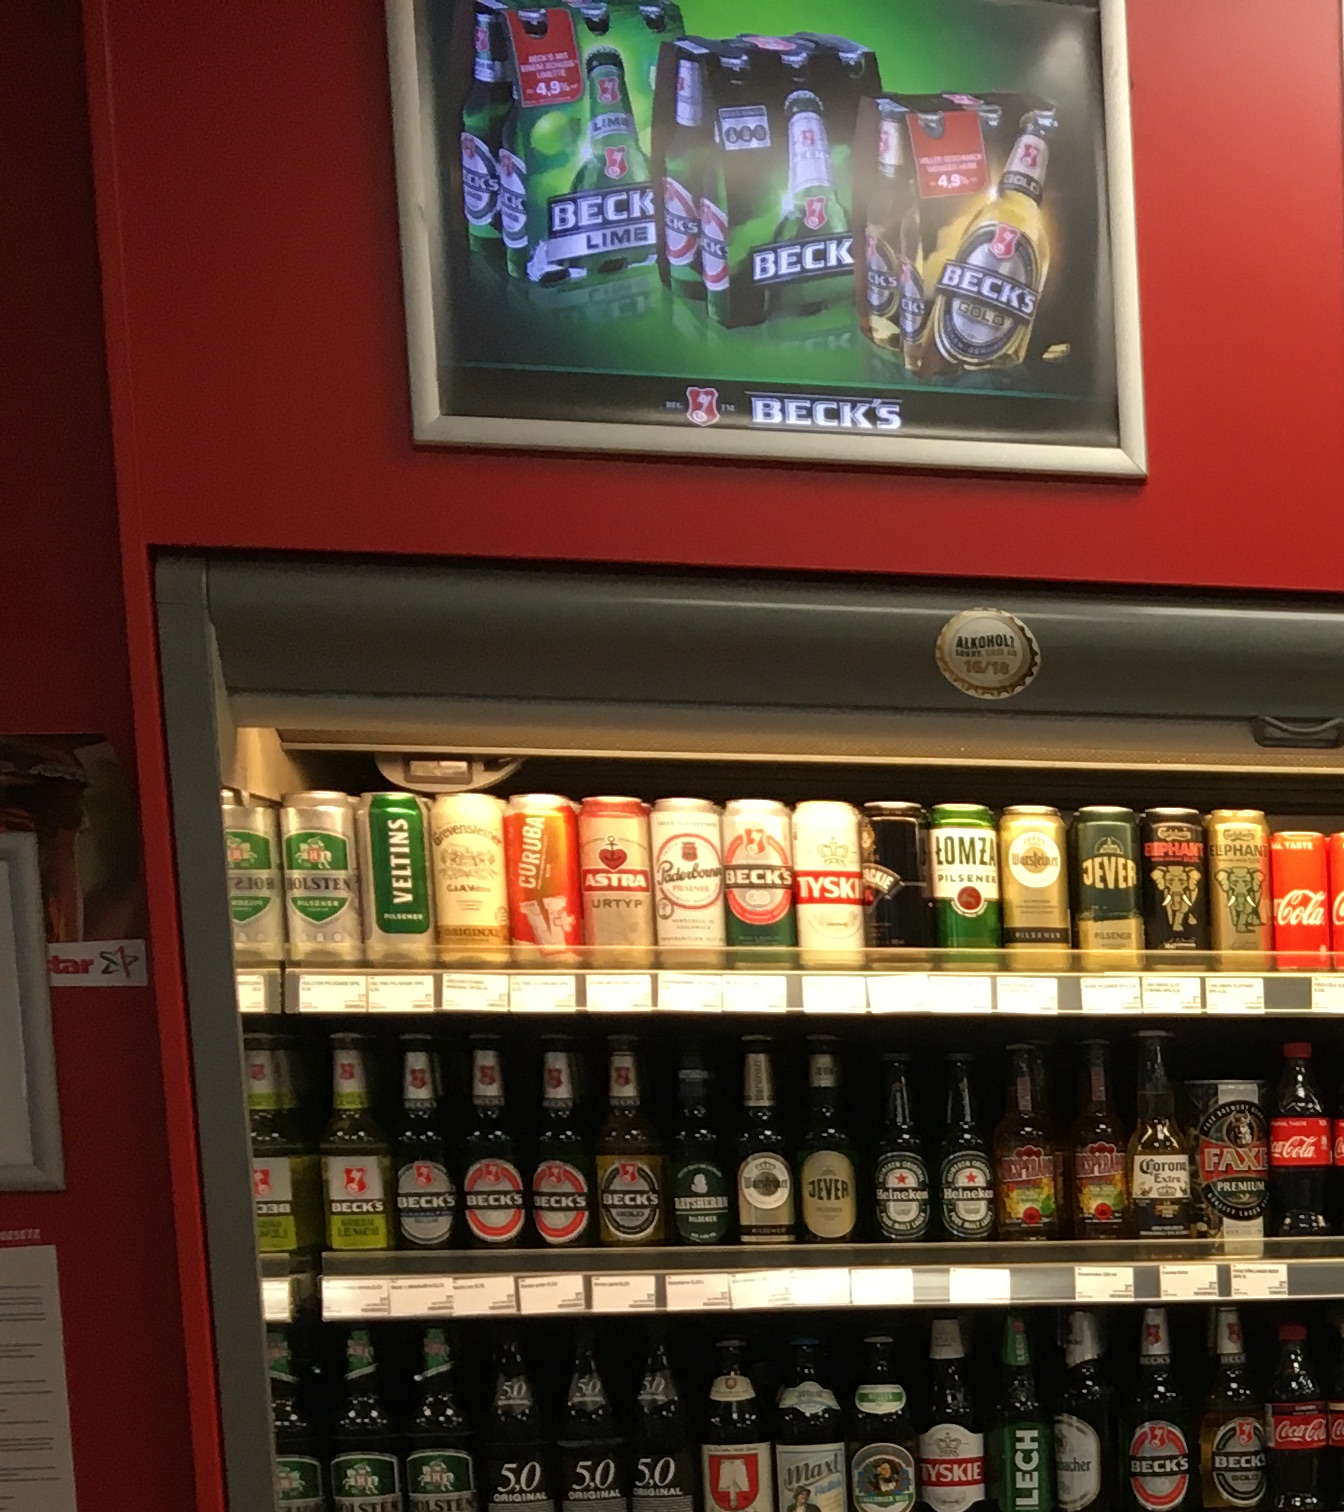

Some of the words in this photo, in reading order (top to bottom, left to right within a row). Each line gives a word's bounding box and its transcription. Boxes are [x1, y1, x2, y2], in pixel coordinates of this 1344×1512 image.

[586, 226, 651, 250] LIME
[942, 266, 1035, 314] BECK'S
[750, 397, 902, 430] BECK'S
[393, 817, 413, 904] VELTINS
[518, 814, 546, 889] CURUBA
[584, 872, 647, 890] ASTRA
[725, 865, 793, 886] BECK'S
[591, 897, 644, 910] URTYP
[1138, 1158, 1188, 1176] Corona
[1203, 1146, 1269, 1172] FAXE
[807, 1178, 850, 1201] JEVER
[875, 1187, 930, 1201] Heineken
[943, 1187, 995, 1201] Heineken
[1216, 1179, 1267, 1194] PREMIUM
[331, 1199, 384, 1214] BECK'S
[397, 1193, 455, 1209] BECK'S
[465, 1192, 523, 1208] BECK'S
[534, 1193, 587, 1208] BECK'S
[602, 1192, 660, 1207] BECK'S
[1130, 1455, 1189, 1473] BECK'S
[1214, 1452, 1267, 1470] BECK'S
[498, 1460, 542, 1493] 5,0
[572, 1458, 617, 1491] 5,0
[636, 1456, 676, 1488] 5,0
